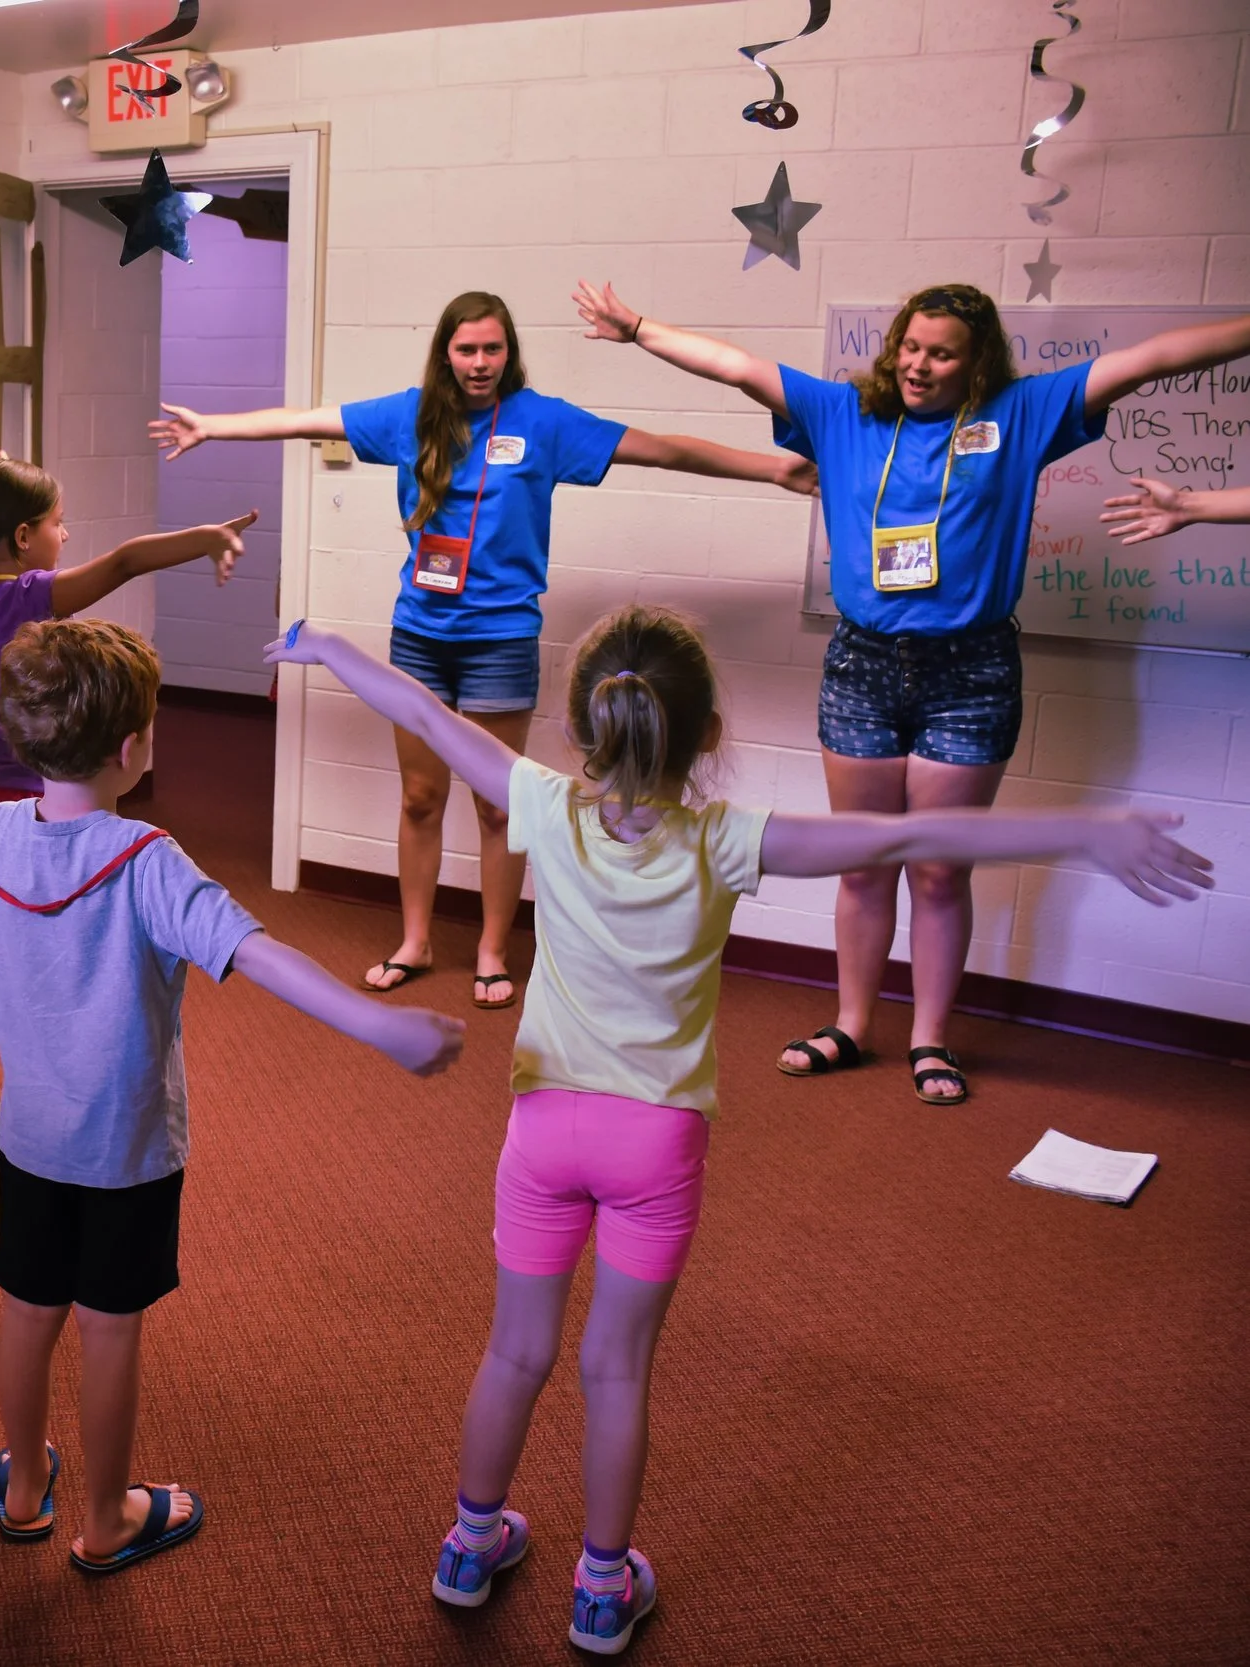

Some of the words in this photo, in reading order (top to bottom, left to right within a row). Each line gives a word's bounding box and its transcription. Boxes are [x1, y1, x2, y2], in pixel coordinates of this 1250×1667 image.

[108, 59, 172, 122] EXIT
[1117, 408, 1171, 439] VBS
[1155, 442, 1234, 490] Song!
[1034, 558, 1093, 592] the
[1103, 557, 1155, 588] love
[1170, 557, 1250, 587] that
[1068, 597, 1090, 619] I
